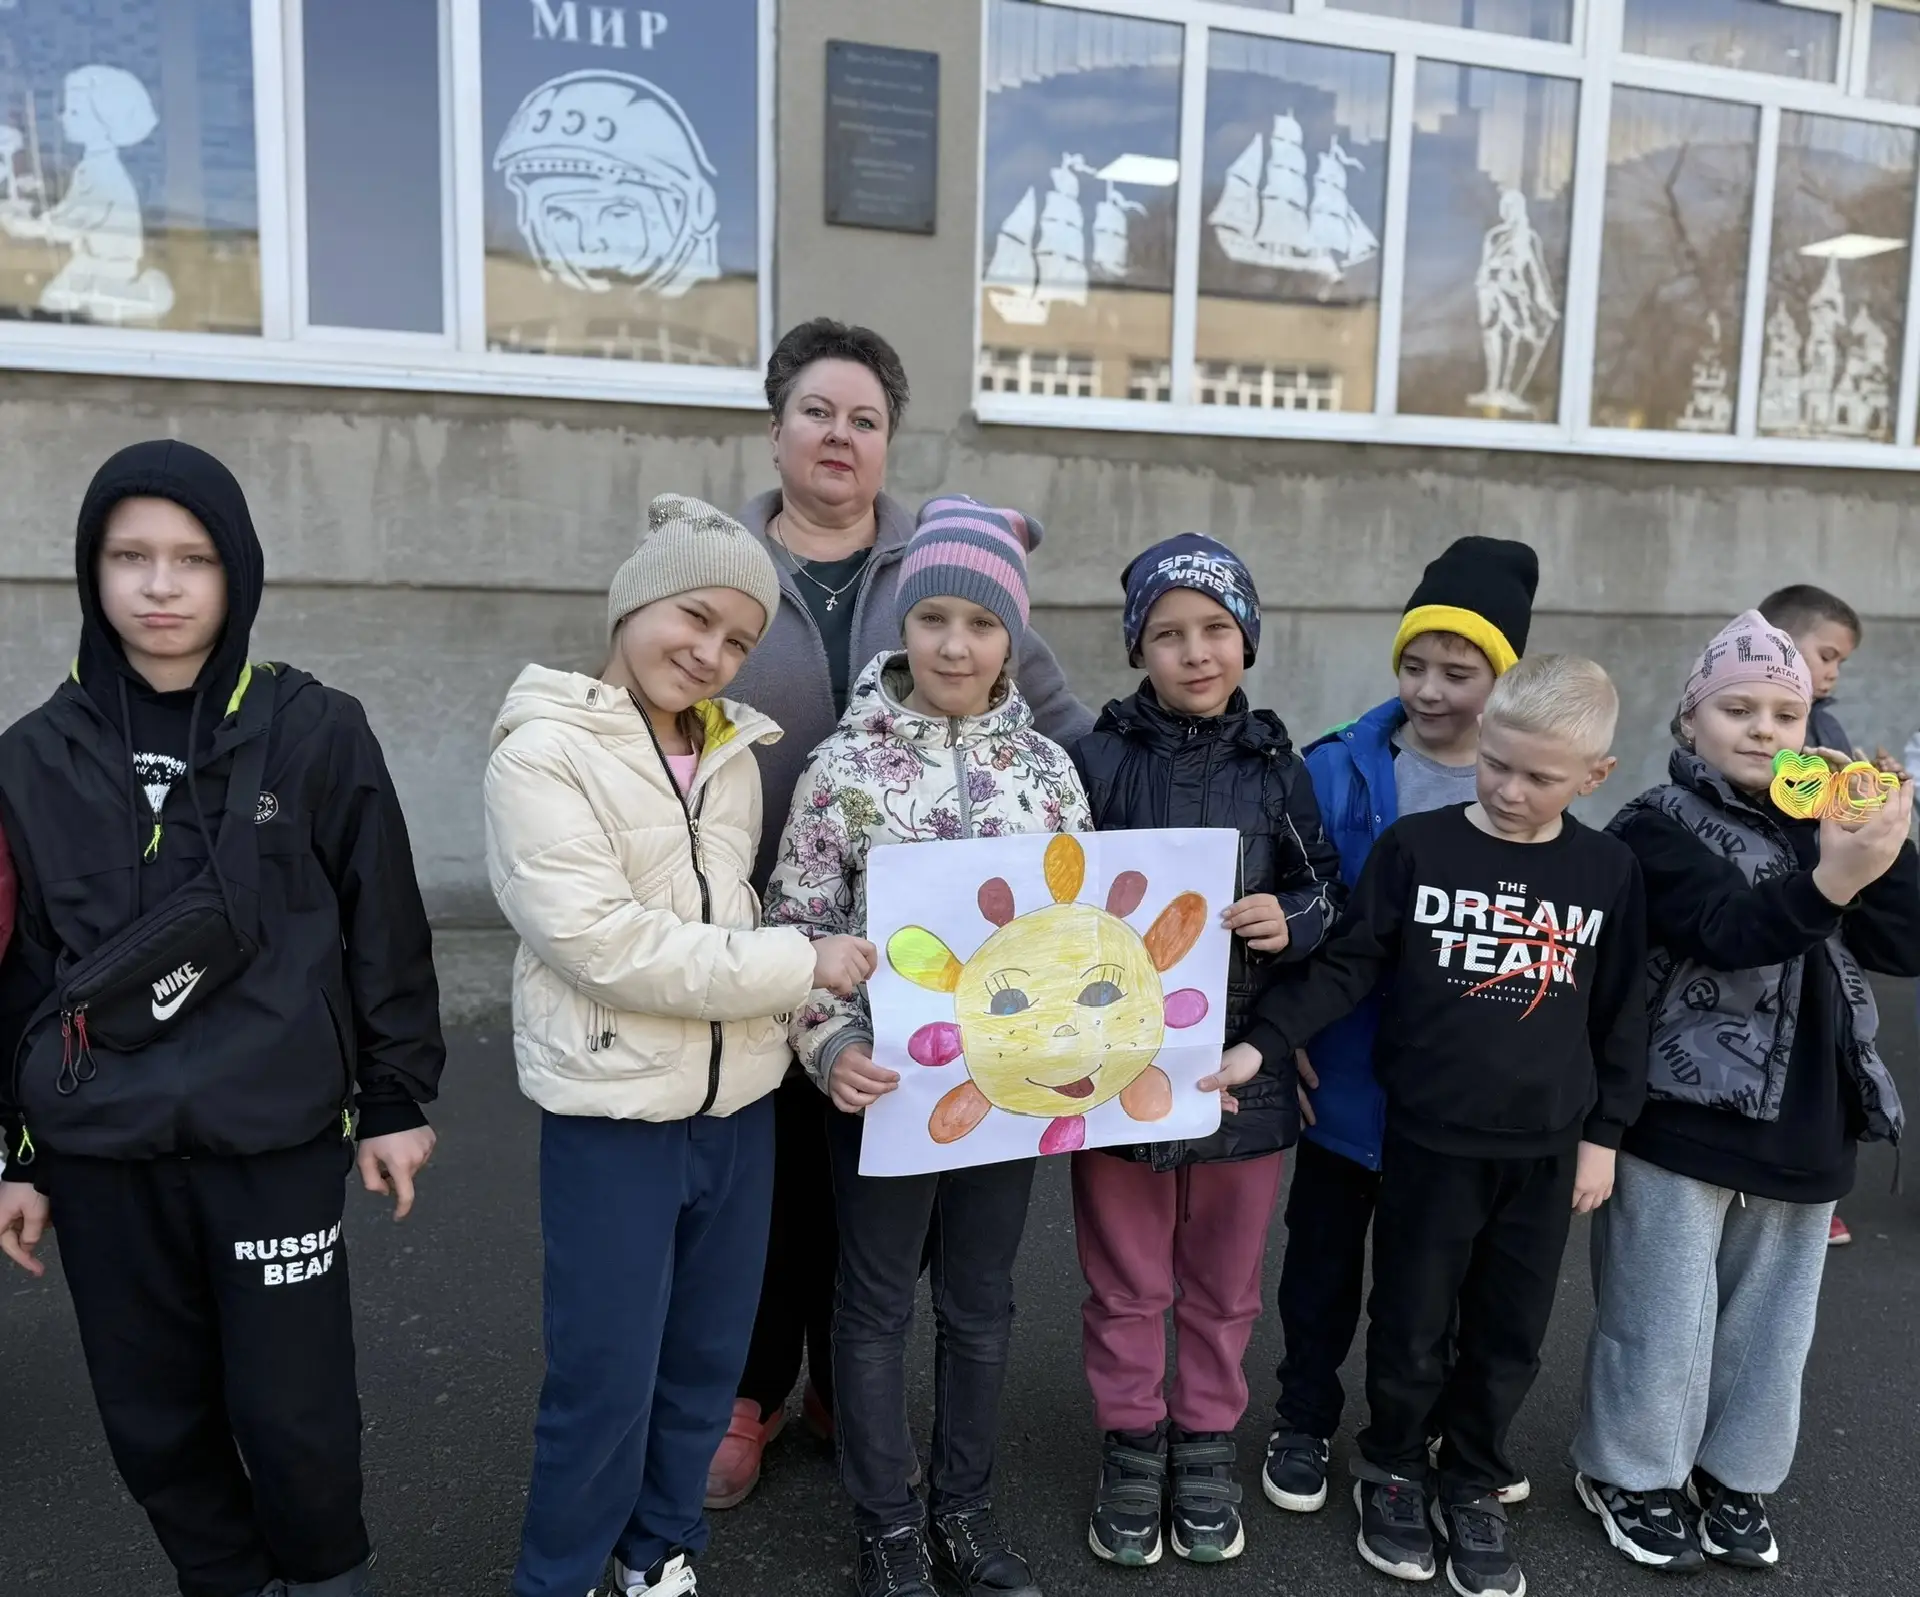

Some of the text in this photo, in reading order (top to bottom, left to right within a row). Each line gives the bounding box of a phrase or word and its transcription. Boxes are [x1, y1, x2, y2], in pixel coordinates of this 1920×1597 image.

[531, 0, 668, 49] МИР
[1158, 555, 1236, 584] SPACE
[1168, 569, 1226, 594] WARS
[1766, 665, 1800, 682] MATATA
[1498, 881, 1528, 894] THE
[1413, 884, 1604, 947] DREAM
[1431, 929, 1578, 985] TEAM
[152, 961, 199, 1001] NIKE
[1447, 978, 1558, 998] BROOYN FREESYLE
[264, 1250, 333, 1286] BEAR
